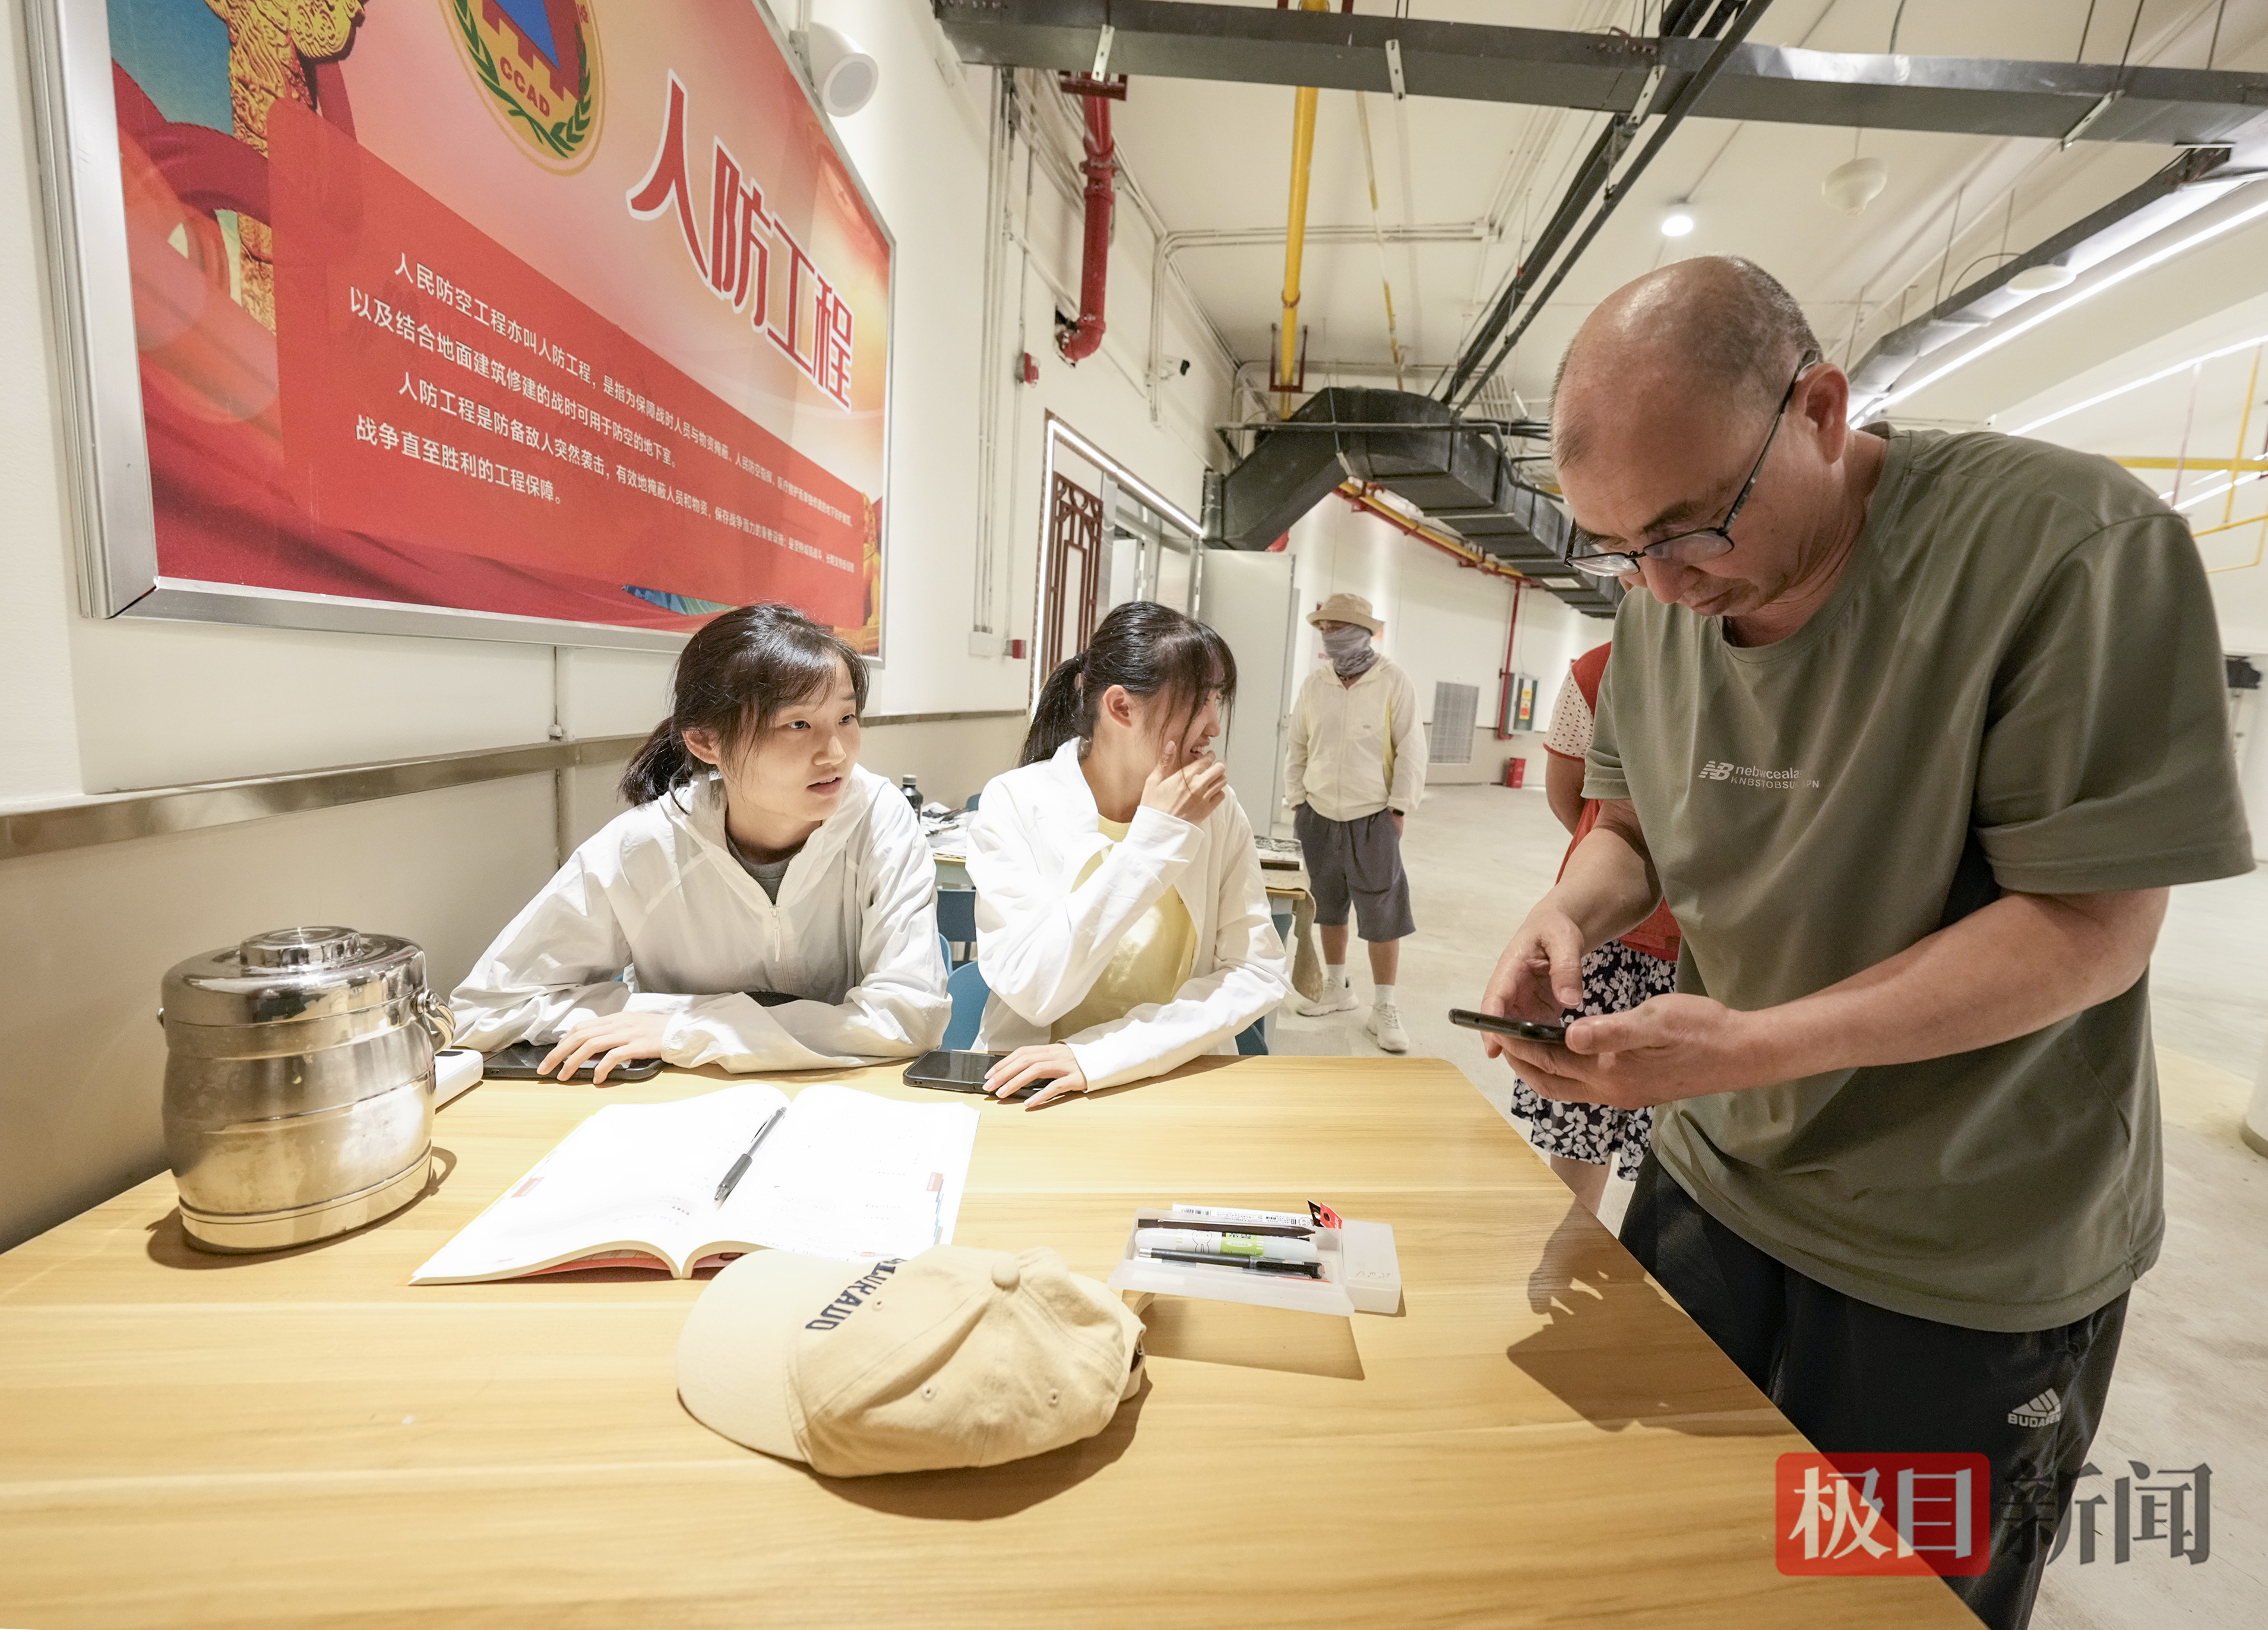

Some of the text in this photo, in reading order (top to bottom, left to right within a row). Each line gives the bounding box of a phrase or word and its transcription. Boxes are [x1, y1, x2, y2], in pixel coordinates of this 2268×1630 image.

[499, 56, 551, 118] CCAD
[627, 69, 853, 413] 人防工程
[350, 286, 676, 468] 以及结合地面建筑修建的战时可用于防空的地下室。
[355, 414, 561, 505] 战争直至胜利的工程保障。
